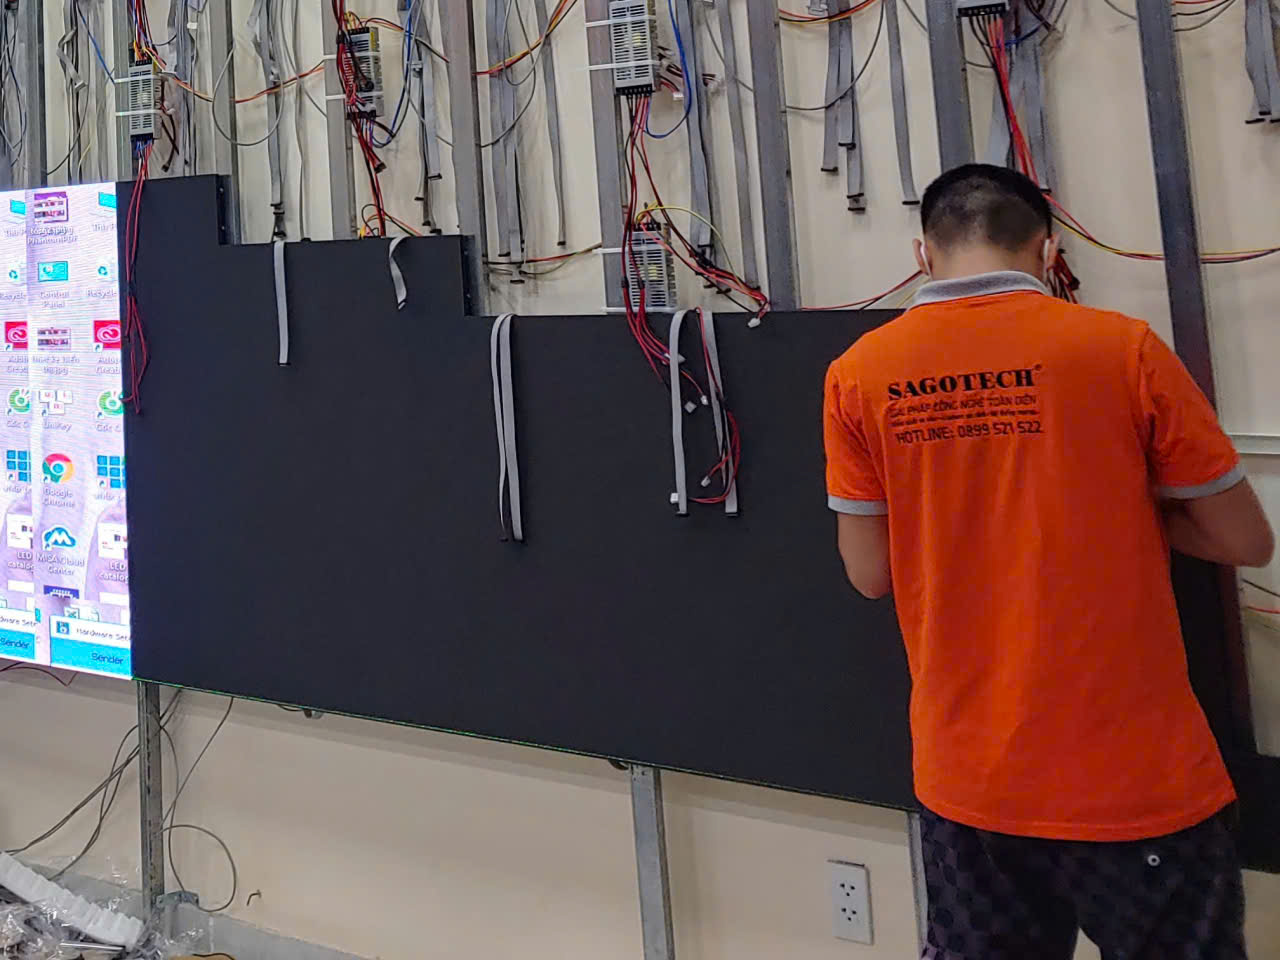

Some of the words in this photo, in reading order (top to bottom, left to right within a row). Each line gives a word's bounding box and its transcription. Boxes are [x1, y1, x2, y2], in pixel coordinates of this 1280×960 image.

[888, 368, 1035, 401] SAGOTECH
[895, 426, 955, 445] HOTLINE:
[957, 422, 991, 438] 0899
[993, 421, 1015, 436] 521
[1017, 420, 1042, 434] 522
[43, 487, 74, 499] Google
[109, 561, 126, 571] LED
[77, 628, 112, 639] Hardware
[0, 638, 29, 649] Sender
[91, 652, 123, 665] Sender
